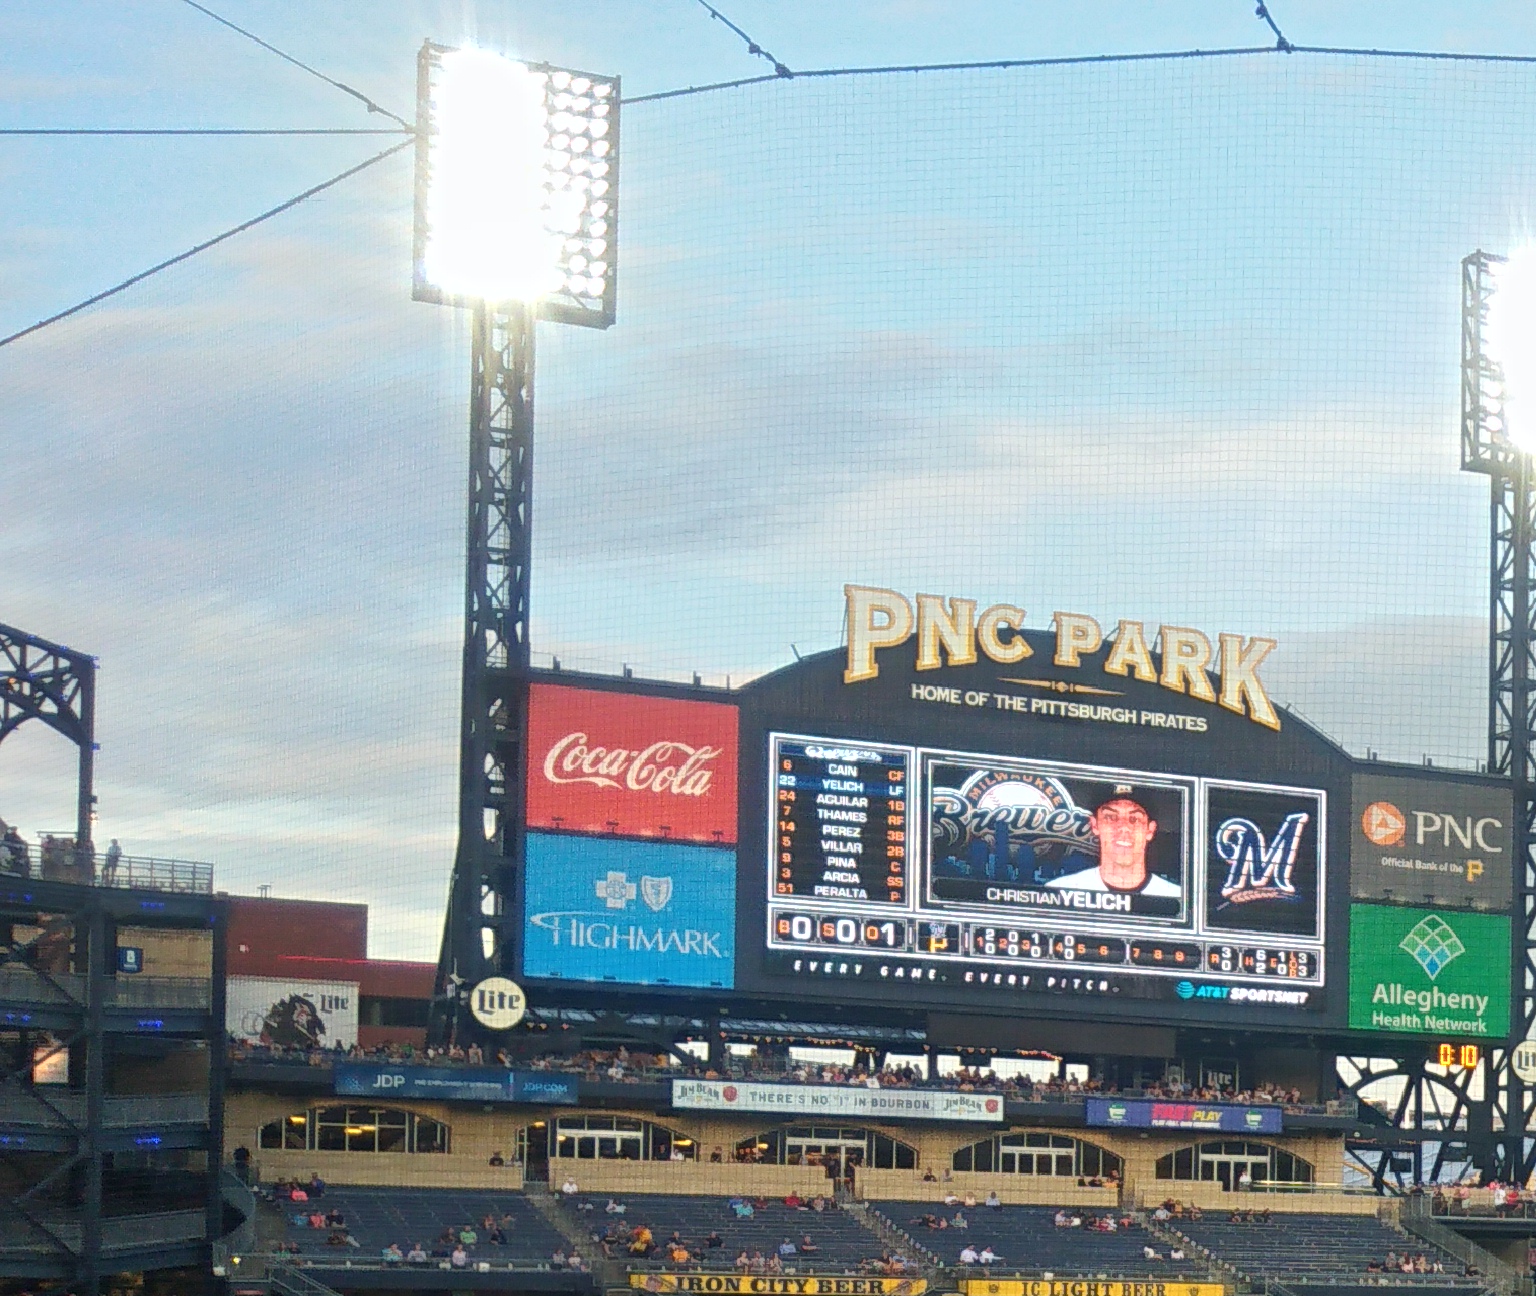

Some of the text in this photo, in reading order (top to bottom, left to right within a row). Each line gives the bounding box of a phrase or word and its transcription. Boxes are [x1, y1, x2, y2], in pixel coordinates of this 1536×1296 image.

[844, 584, 1282, 732] PNC PARK
[911, 683, 1208, 733] HOME OF THE PITTSBURGH PIRATES
[544, 733, 724, 797] Coca-Cola
[828, 764, 858, 777] CAIN
[822, 779, 864, 792] YELICH
[816, 794, 868, 808] AGUILAR
[817, 809, 868, 824] THAMES
[933, 787, 1099, 846] Brewer
[822, 825, 862, 838] PEREZ
[1412, 810, 1503, 853] PNC
[821, 840, 863, 854] VILLAR
[827, 856, 857, 869] PINA
[1381, 856, 1415, 870] Official
[1416, 859, 1438, 872] Bank
[1439, 862, 1449, 872] of
[1449, 862, 1464, 873] the
[823, 871, 861, 884] ARCIA
[814, 885, 868, 900] PERALTA
[987, 888, 1131, 912] CHRISTIAN YELICH
[533, 914, 724, 958] HIGHMARK
[794, 959, 864, 975] EVERY
[965, 971, 1031, 987] EVERY
[319, 993, 350, 1014] Lite
[476, 989, 522, 1017] Lite
[1196, 985, 1310, 1004] AT&T SPORTSNET
[1372, 983, 1489, 1016] Allegheny
[1372, 1011, 1488, 1034] Health Network
[1439, 1043, 1479, 1067] 0:10
[373, 1074, 405, 1088] JDP
[811, 1094, 829, 1106] NO
[1192, 1111, 1223, 1122] PLAY
[675, 1276, 885, 1295] IRON CITY BEER
[1021, 1282, 1041, 1296] IC
